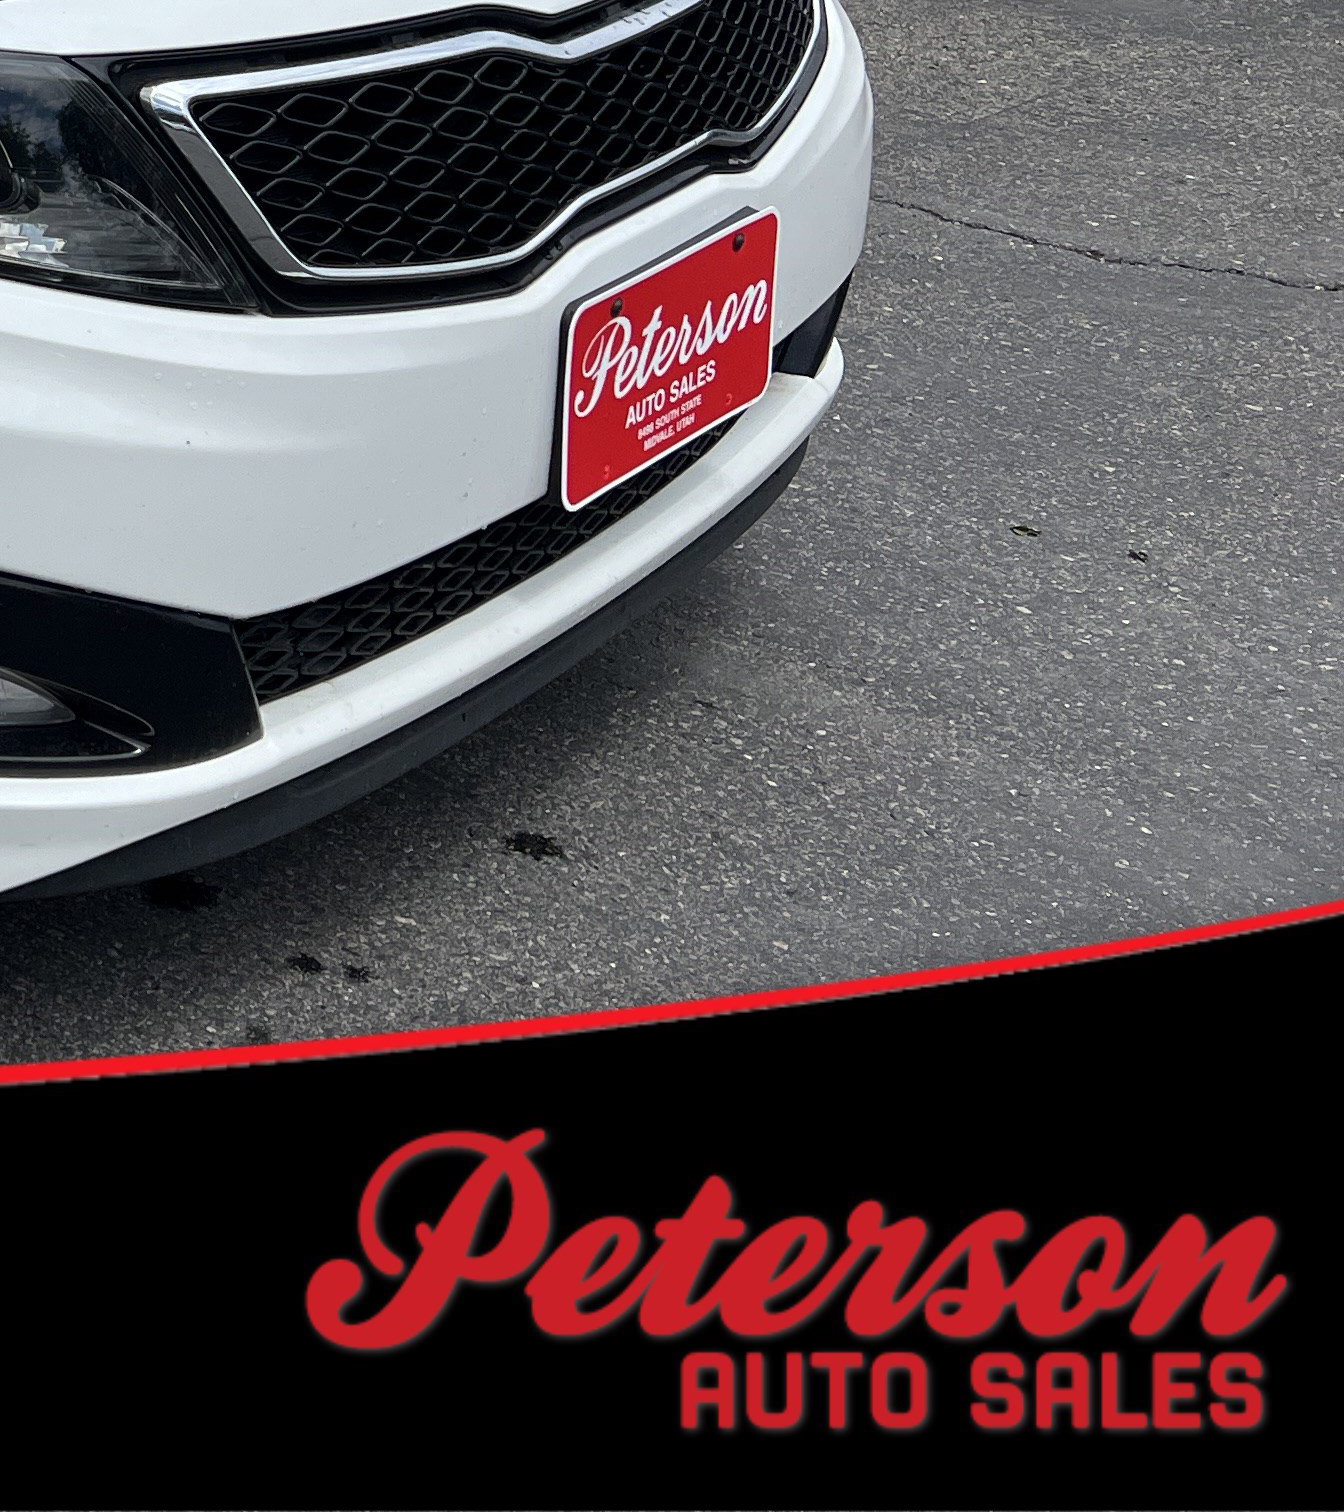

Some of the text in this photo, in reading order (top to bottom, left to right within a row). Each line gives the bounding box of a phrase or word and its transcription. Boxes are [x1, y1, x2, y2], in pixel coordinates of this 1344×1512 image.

[573, 279, 768, 418] Peterson
[625, 359, 716, 429] AUTO SALES
[655, 406, 680, 430] SOUTH
[680, 393, 702, 415] STATE
[676, 412, 696, 433] UTAH
